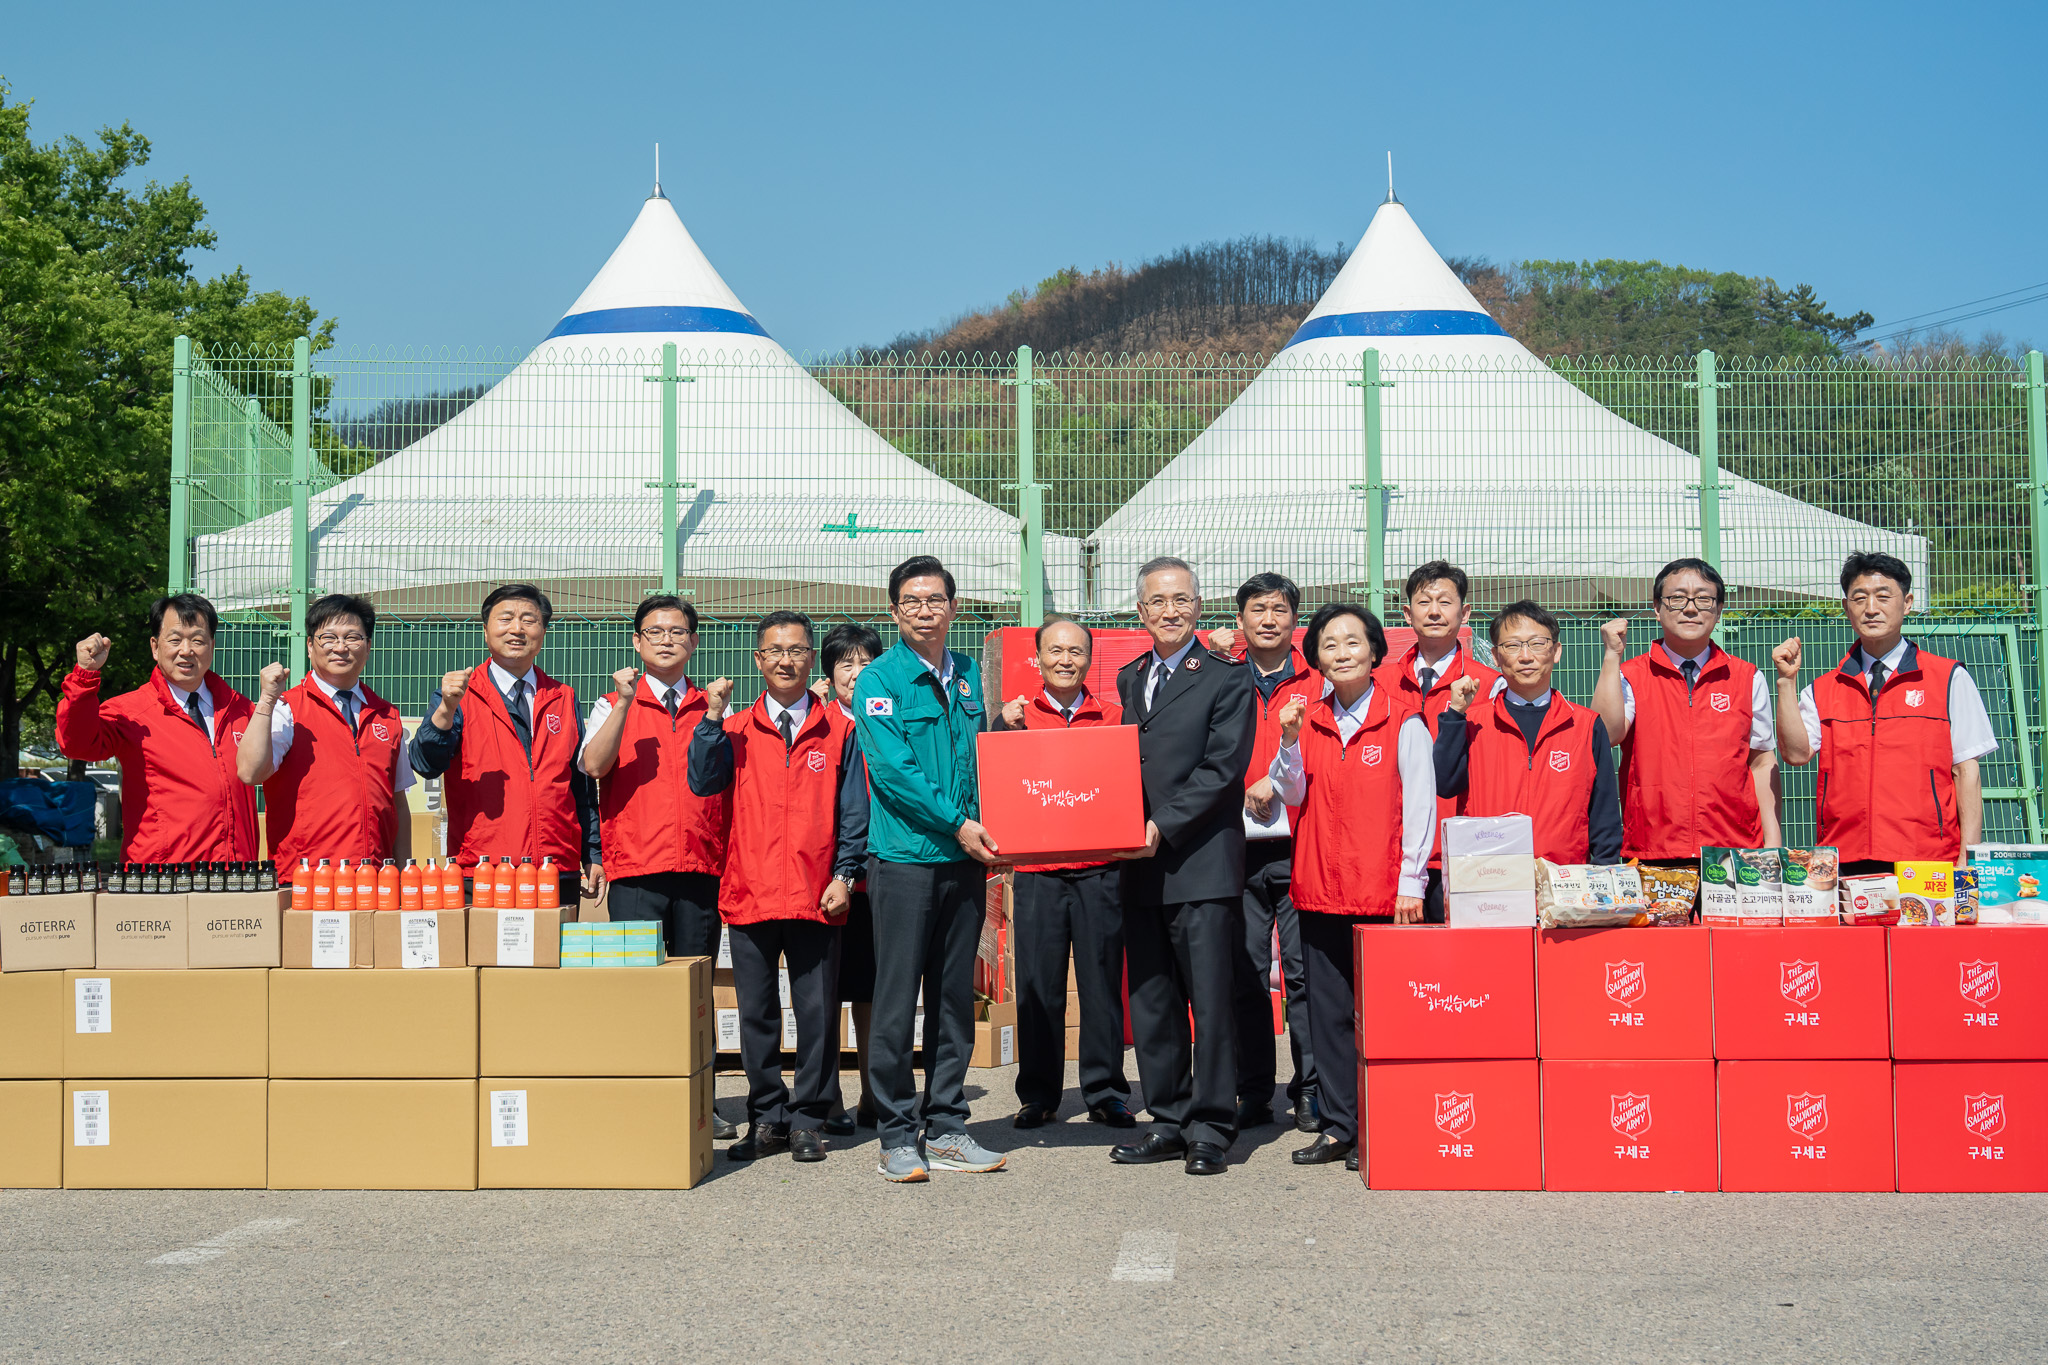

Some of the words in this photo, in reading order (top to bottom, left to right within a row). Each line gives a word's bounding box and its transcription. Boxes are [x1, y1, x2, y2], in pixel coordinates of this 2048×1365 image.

[1475, 830, 1505, 841] Kleenex
[1477, 867, 1508, 878] Kleenex
[1708, 868, 1726, 877] bibigo
[1741, 870, 1760, 880] bibigo
[1788, 869, 1806, 878] bibigo
[1932, 872, 1946, 880] 3분
[1650, 880, 1695, 900] 삼선짜장
[1924, 881, 1947, 892] 짜장
[1788, 895, 1813, 904] 육개장
[1477, 902, 1508, 914] Kleenex
[1612, 965, 1628, 980] THE
[1788, 965, 1802, 979] THE
[1967, 965, 1982, 979] THE
[1608, 967, 1640, 994] SALVATION
[1783, 966, 1815, 994] SALVATION
[1962, 966, 1995, 994] SALVATION
[1620, 981, 1640, 999] ARMY
[1795, 979, 1815, 999] ARMY
[1974, 979, 1995, 999] ARMY
[1608, 1013, 1645, 1026] 구세군
[1784, 1013, 1820, 1026] 구세군
[1963, 1013, 1999, 1026] 구세군
[1442, 1096, 1457, 1110] THE
[1618, 1097, 1633, 1111] THE
[1794, 1097, 1809, 1111] THE
[1972, 1098, 1987, 1112] THE
[1437, 1098, 1470, 1126] SALVATION
[1613, 1099, 1646, 1127] SALVATION
[1790, 1099, 1823, 1127] SALVATION
[1967, 1100, 2000, 1128] SALVATION
[1450, 1111, 1470, 1131] ARMY
[1626, 1112, 1646, 1132] ARMY
[1802, 1112, 1822, 1132] ARMY
[1980, 1112, 2000, 1132] ARMY
[1438, 1144, 1474, 1158] 구세군
[1614, 1146, 1650, 1159] 구세군
[1790, 1146, 1826, 1159] 구세군
[1968, 1146, 2004, 1160] 구세군
